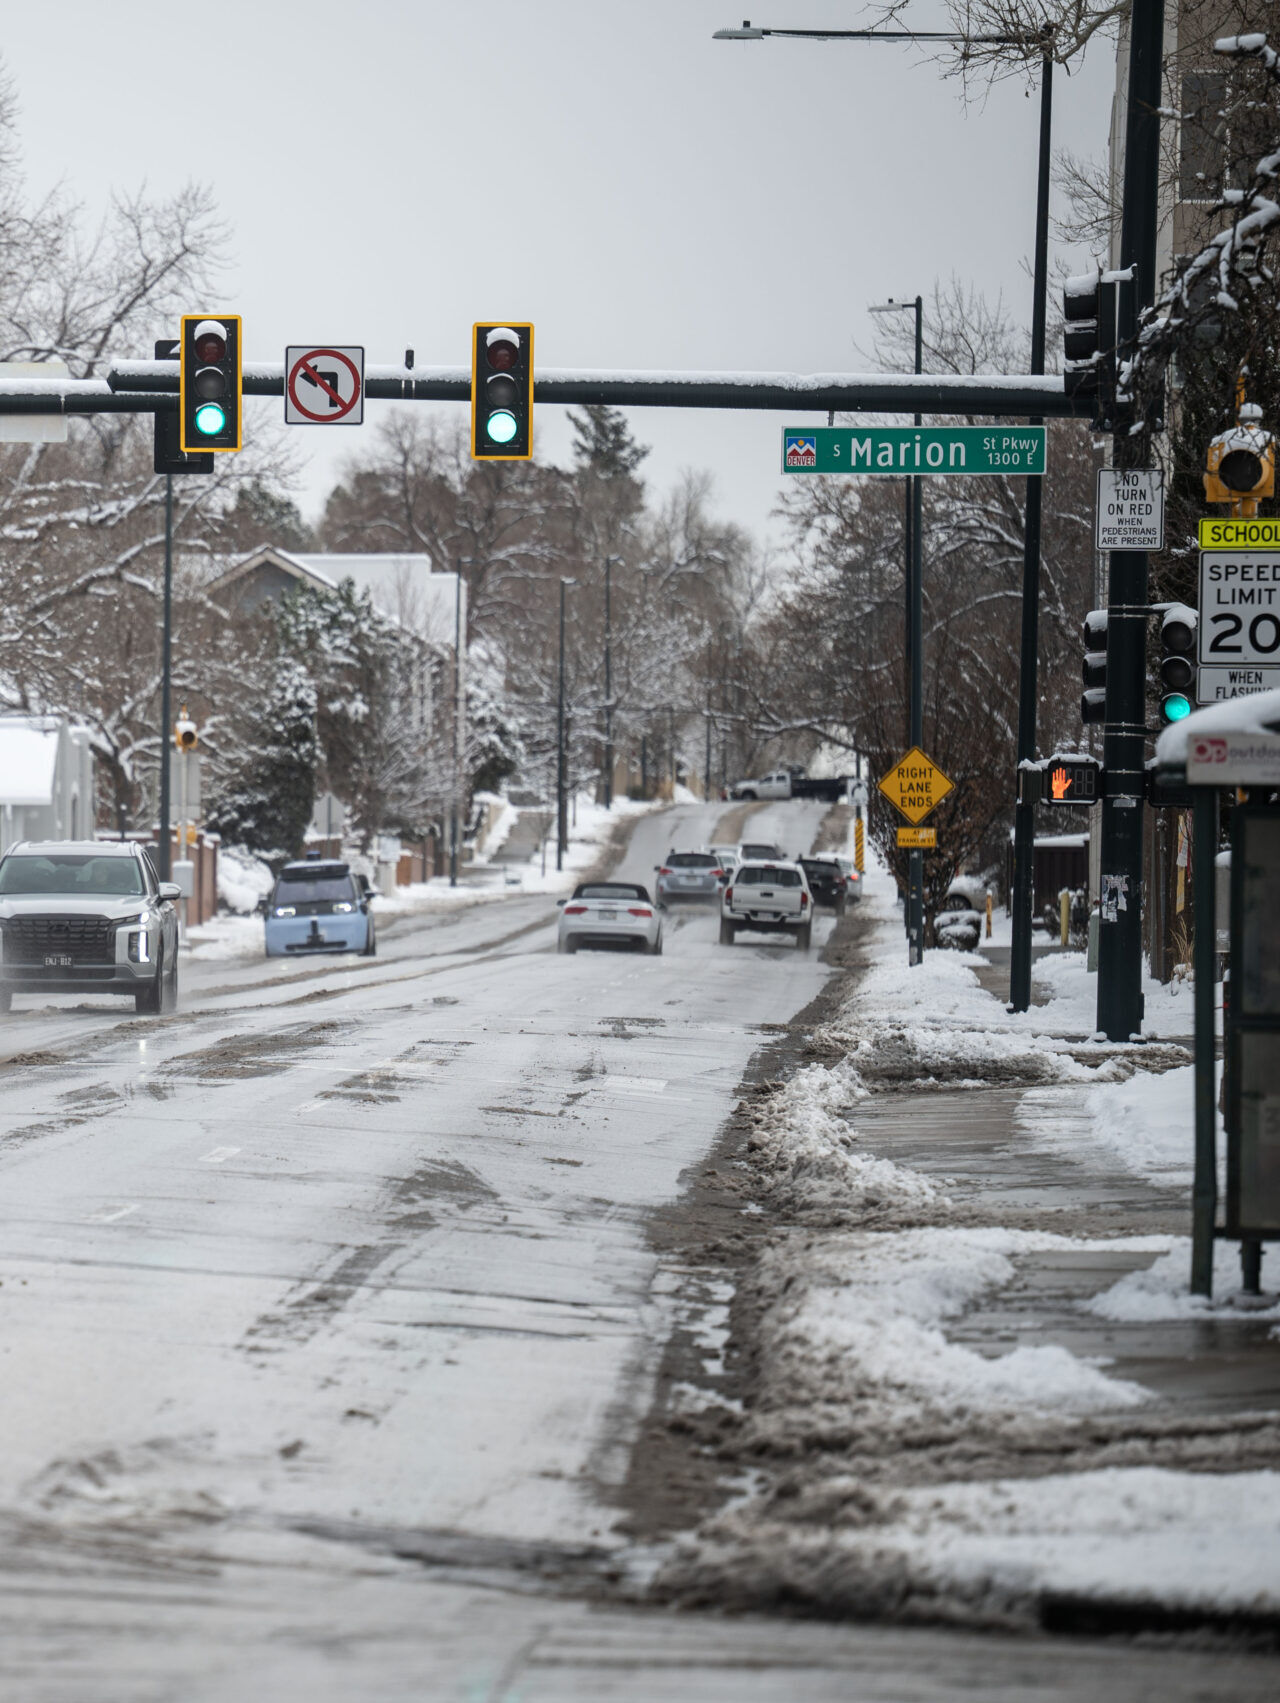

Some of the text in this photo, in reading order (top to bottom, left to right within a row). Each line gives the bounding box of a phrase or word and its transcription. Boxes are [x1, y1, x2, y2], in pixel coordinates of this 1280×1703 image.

[833, 435, 966, 467] S Marion
[983, 437, 1038, 454] St Pkwy
[787, 456, 816, 466] DENVER
[988, 453, 1034, 465] 1300 E
[1122, 474, 1139, 486] NO
[1115, 489, 1147, 501] TURN
[1108, 503, 1153, 515] ON RED
[1118, 518, 1143, 526] WHEN
[1102, 527, 1157, 536] PEDESTRIANS
[1211, 525, 1280, 542] SCHOOL
[1101, 537, 1158, 545] ARE PRESENT
[1208, 564, 1280, 582] SPEED
[1217, 588, 1277, 605] LIMIT
[1209, 613, 1280, 654] 20
[1229, 671, 1263, 684] WHEN
[897, 767, 934, 779] RIGHT
[900, 782, 932, 793] LANE
[900, 796, 933, 808] ENDS
